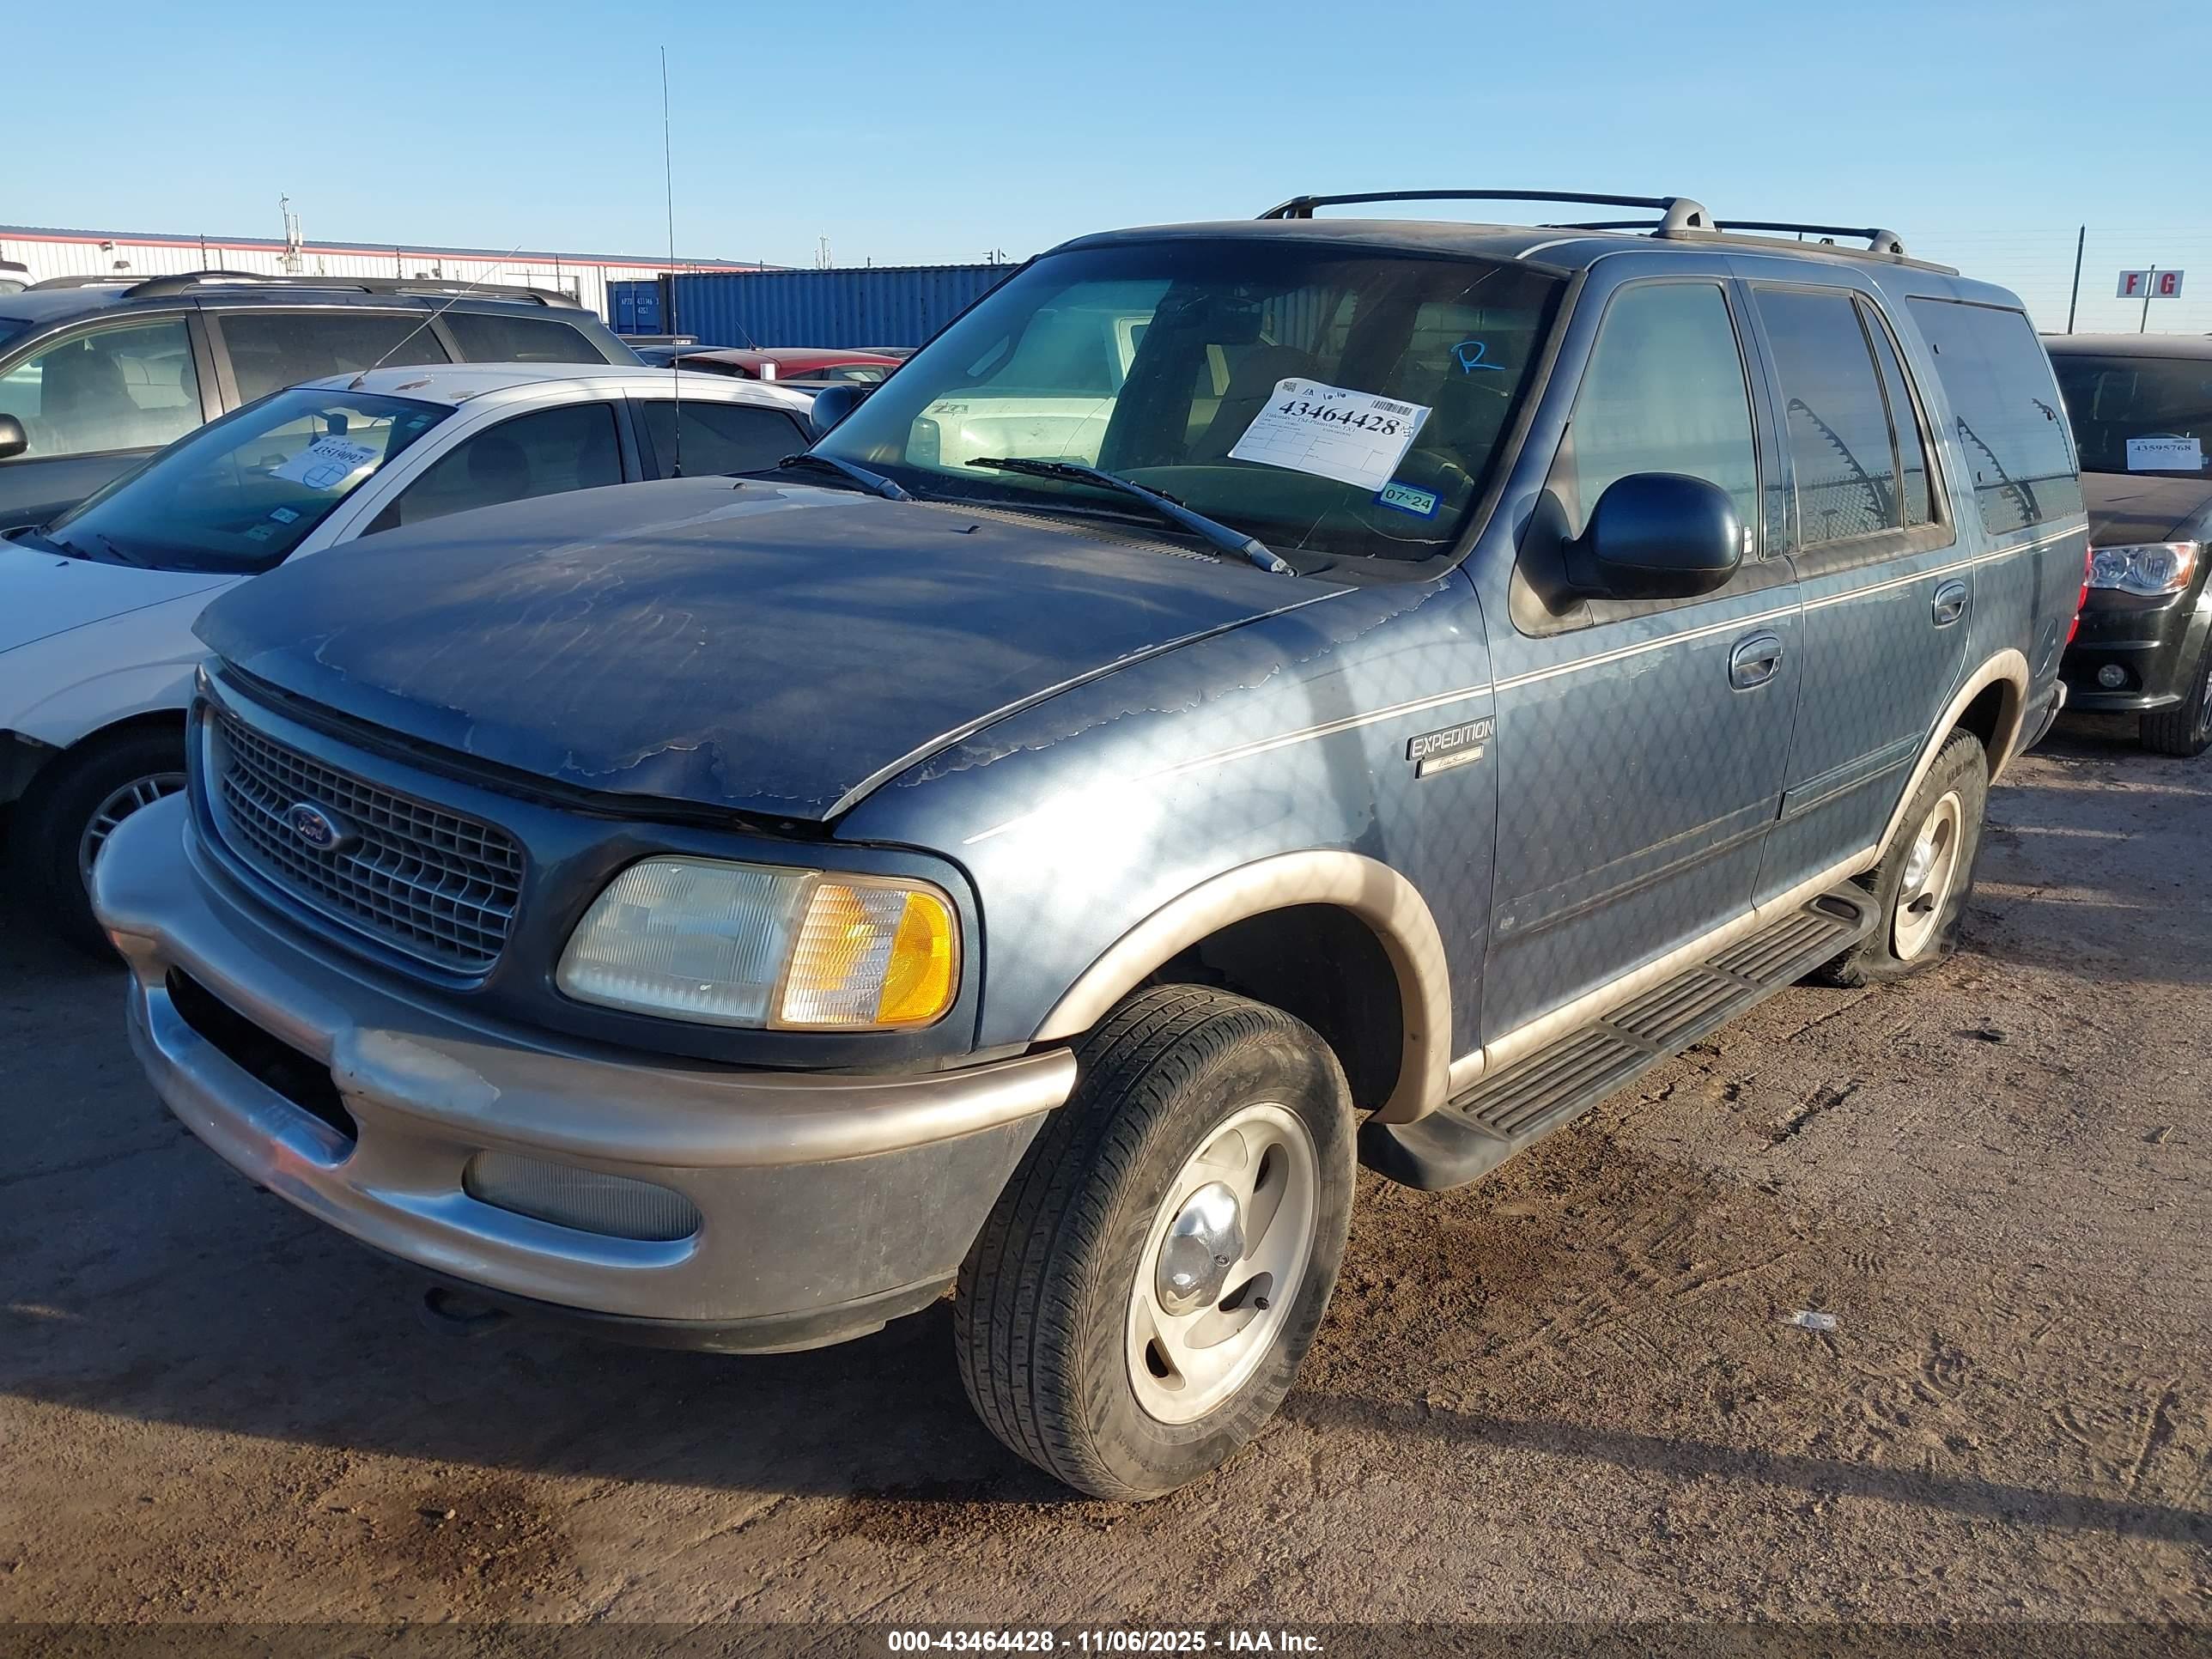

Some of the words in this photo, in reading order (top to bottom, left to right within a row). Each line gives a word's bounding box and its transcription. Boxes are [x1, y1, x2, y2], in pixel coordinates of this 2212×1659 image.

[2125, 274, 2138, 295] F
[2160, 273, 2175, 295] G
[1450, 341, 1505, 374] R
[1279, 400, 1401, 436] 43464428
[1385, 489, 1407, 501] 07
[1411, 495, 1431, 510] 24
[1412, 719, 1496, 758] EXPEDITION
[298, 811, 325, 842] Ford
